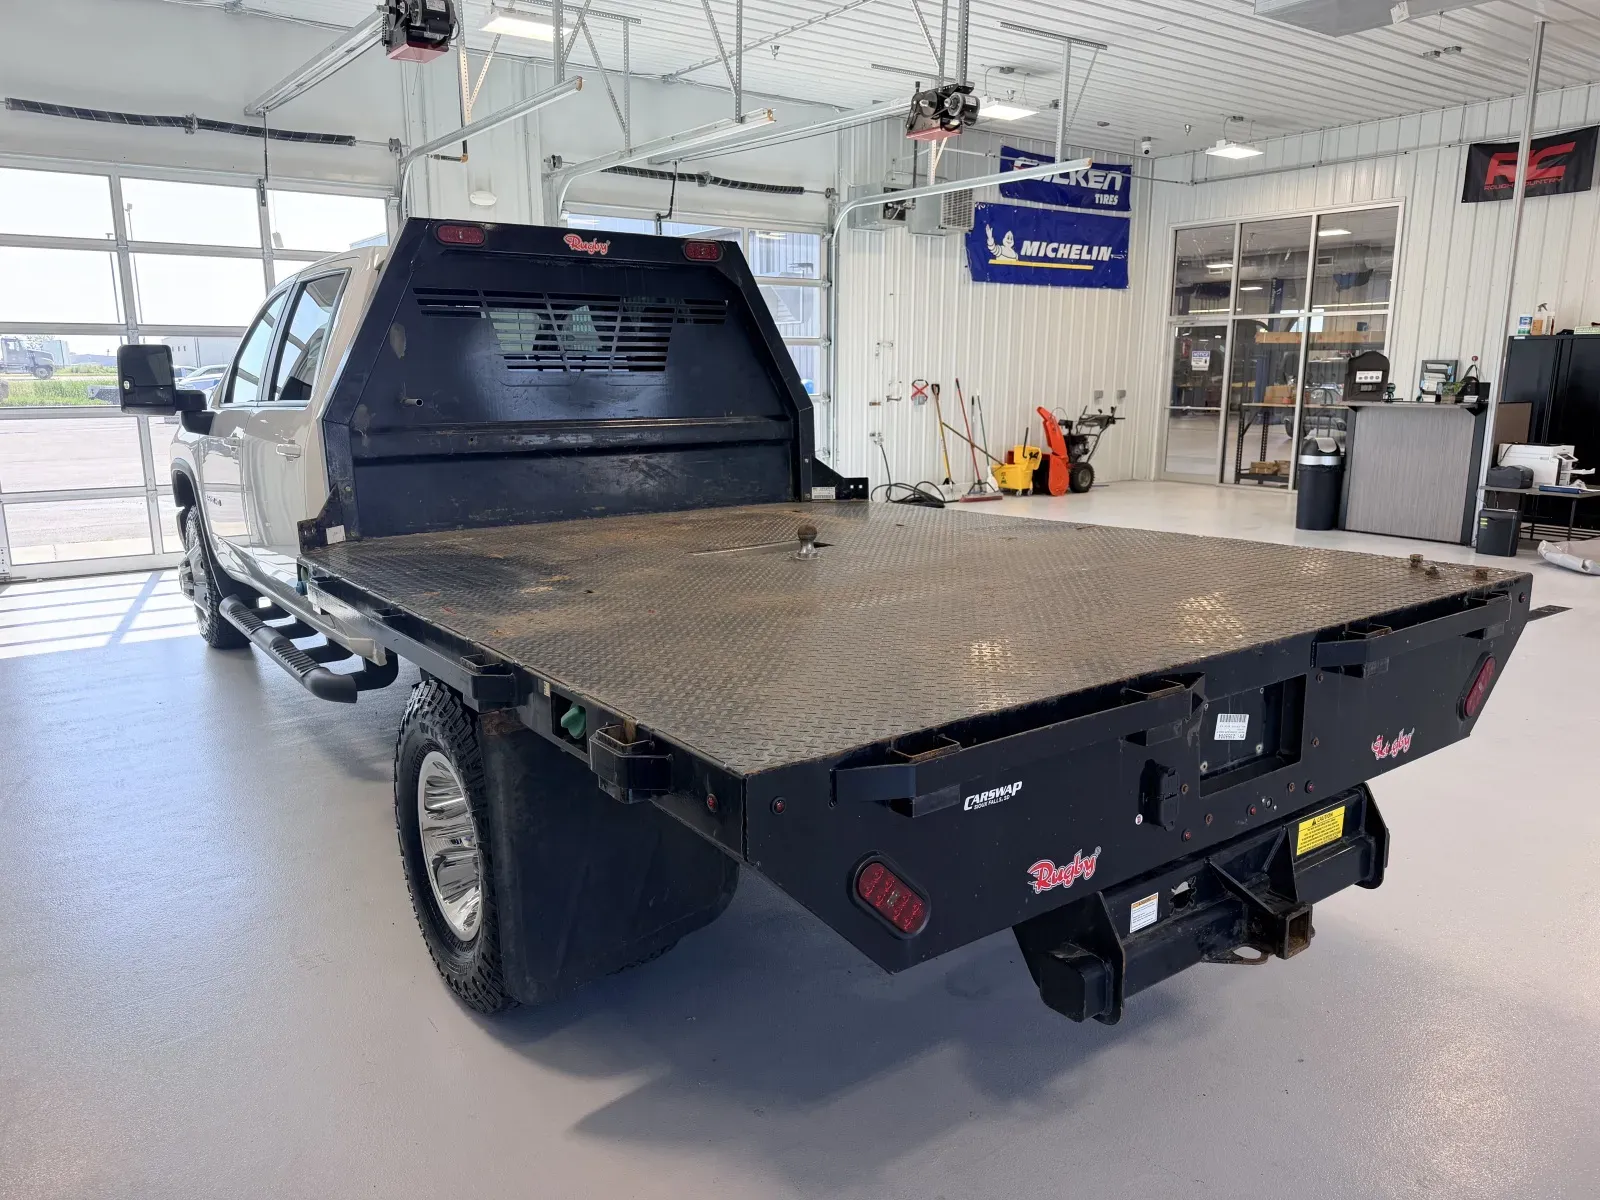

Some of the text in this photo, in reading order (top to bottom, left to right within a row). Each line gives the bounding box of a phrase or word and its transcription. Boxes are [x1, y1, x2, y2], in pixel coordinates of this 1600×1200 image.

[1094, 193, 1119, 206] TIRES
[563, 233, 609, 255] Rugby
[1020, 240, 1113, 262] MICHELIN
[964, 781, 1023, 811] CARSWAP
[1027, 847, 1101, 894] Rugby
